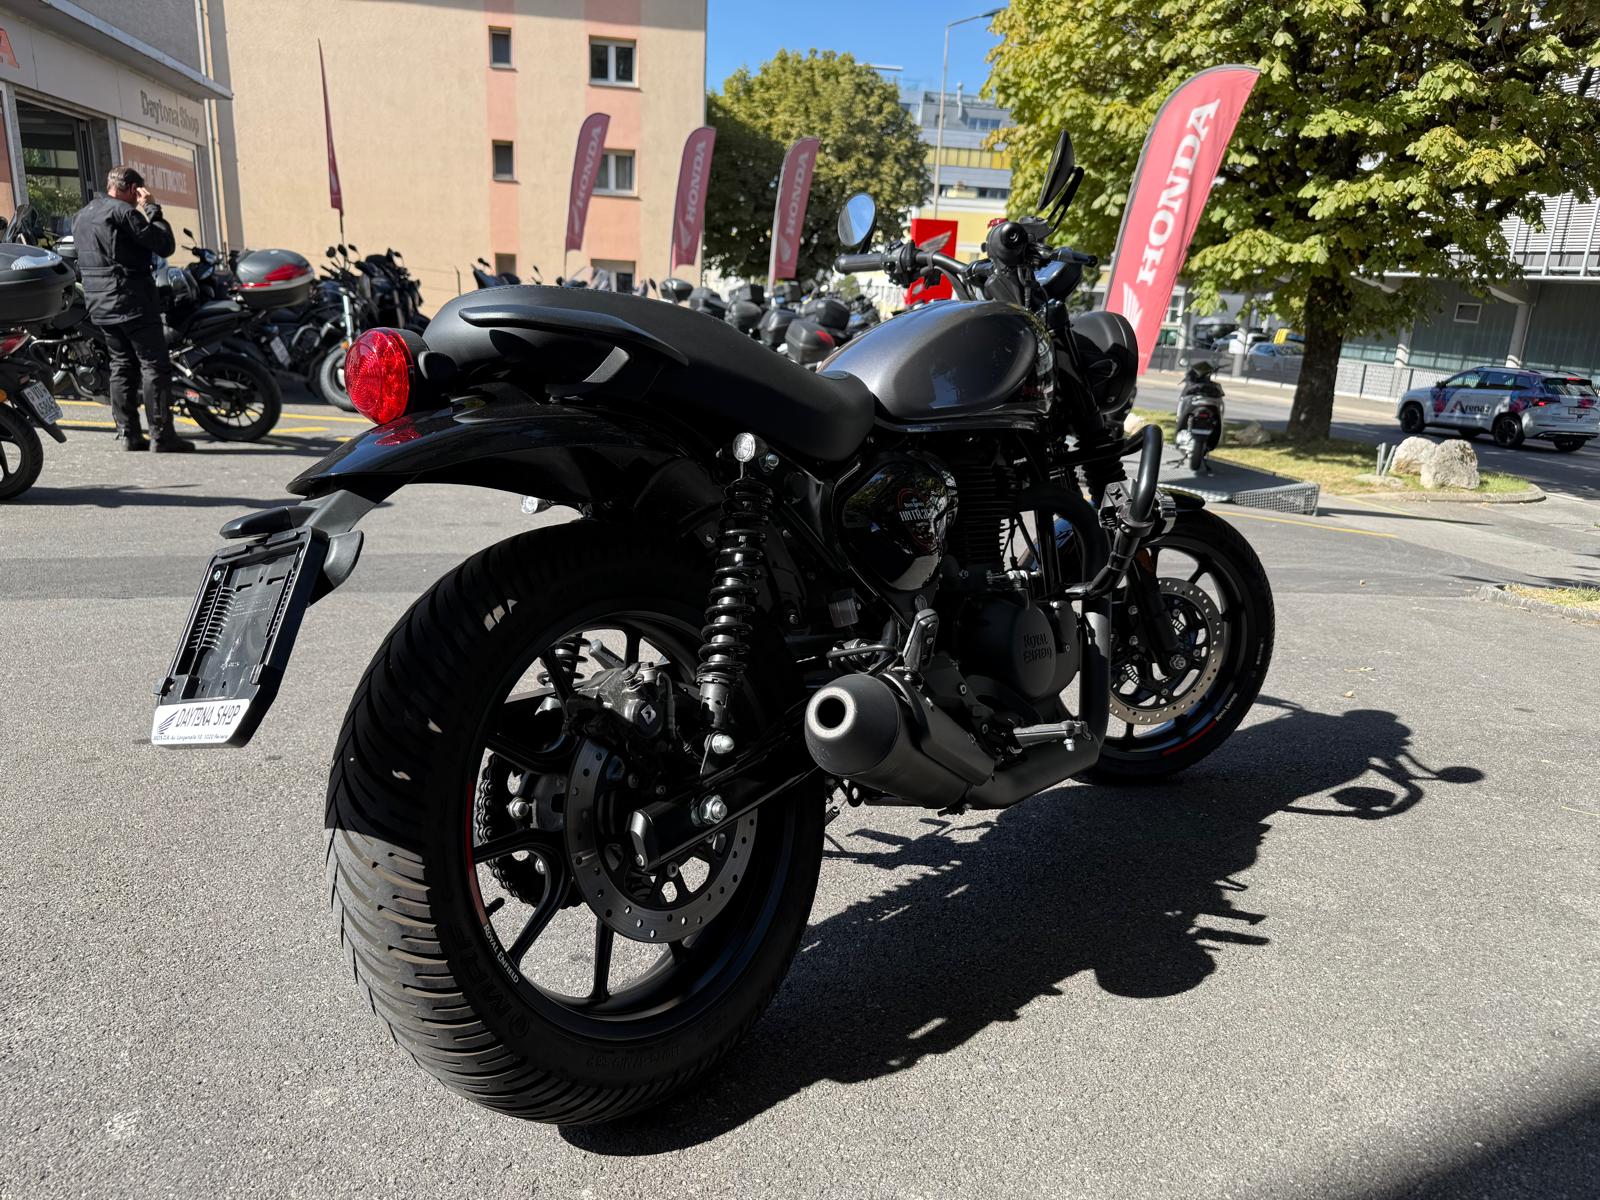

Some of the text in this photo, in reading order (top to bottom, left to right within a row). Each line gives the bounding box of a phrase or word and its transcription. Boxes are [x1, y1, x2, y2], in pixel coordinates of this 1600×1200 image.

[140, 88, 200, 138] Daytona Shop
[575, 125, 602, 209] HONDA
[686, 139, 707, 225] HONDA
[785, 151, 810, 237] HONDA
[1135, 98, 1220, 287] HONDA
[175, 704, 241, 728] DAYTONA SHOP
[483, 923, 520, 984] ROYAL ENFIELD
